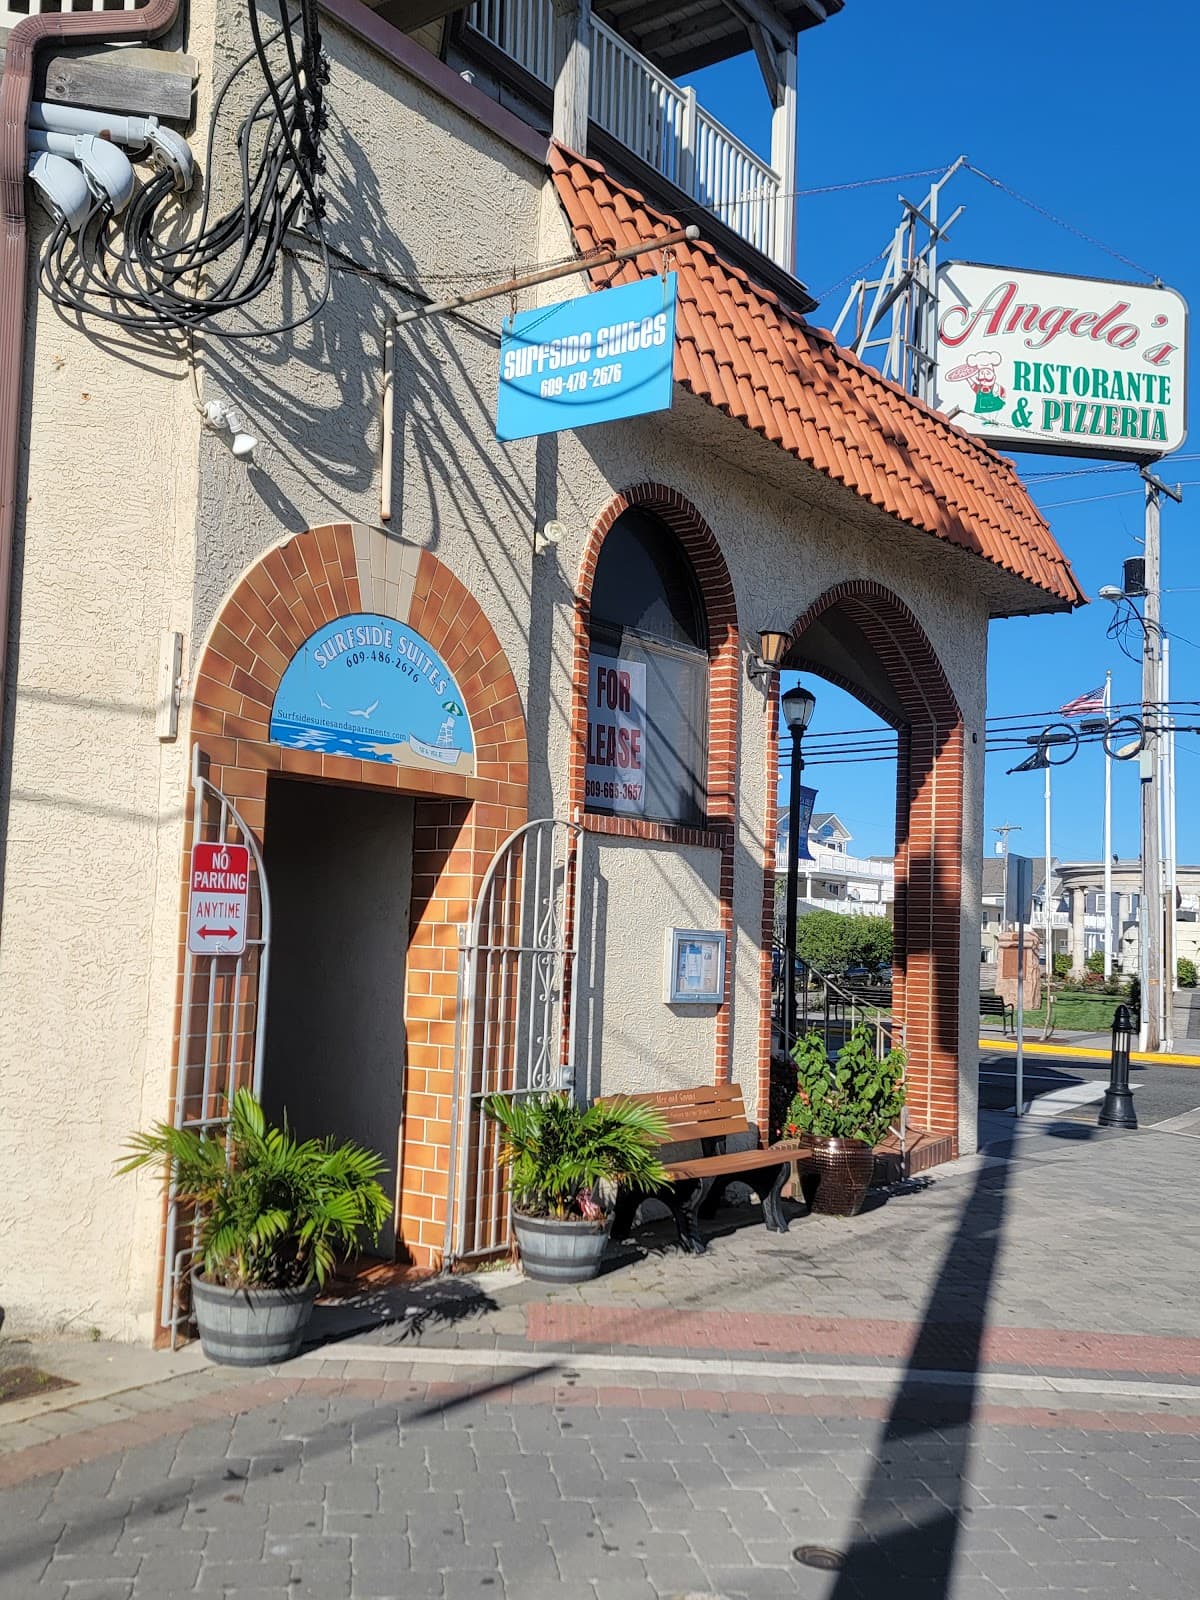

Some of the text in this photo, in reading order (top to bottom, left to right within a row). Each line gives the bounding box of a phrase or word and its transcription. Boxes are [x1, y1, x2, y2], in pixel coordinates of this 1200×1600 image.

[938, 281, 1178, 365] Angelo's
[540, 363, 622, 398] 609-478-2676
[1012, 361, 1171, 405] RISTORANTE
[1011, 397, 1168, 442] & PIZZERIA
[314, 627, 447, 695] SURFSIDE SUITES
[597, 666, 630, 712] FOR
[277, 709, 407, 741] Surfsidesuitesandapartments.com
[586, 722, 641, 769] LEASE
[585, 780, 642, 801] 609-665-3657
[194, 871, 246, 890] PARKING
[212, 852, 229, 870] NO
[196, 901, 240, 919] ANYTIME
